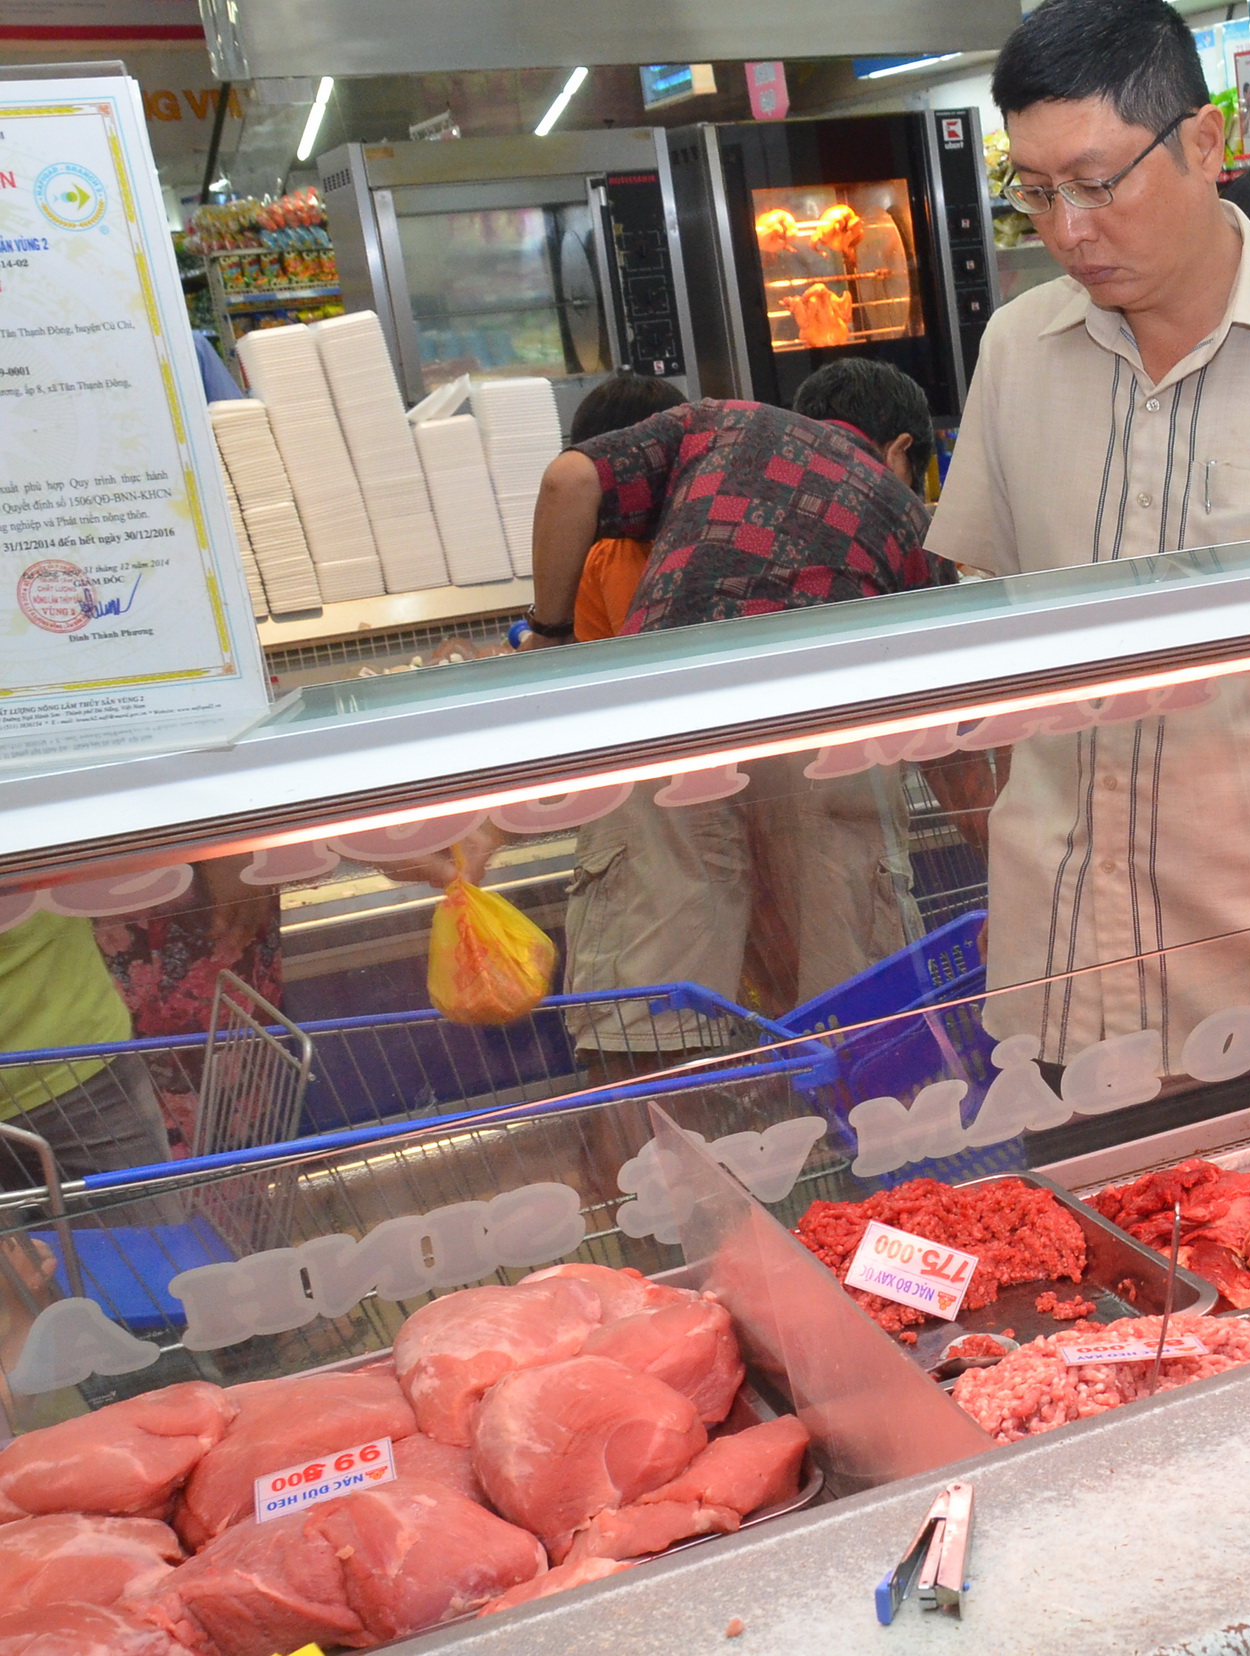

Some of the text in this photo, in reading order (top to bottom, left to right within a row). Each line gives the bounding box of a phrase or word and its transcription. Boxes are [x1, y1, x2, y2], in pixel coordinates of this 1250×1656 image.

[69, 477, 90, 490] Quy
[3, 537, 56, 552] 31/12/2014
[124, 527, 176, 542] 30/12/2016
[150, 558, 170, 568] 2014
[874, 1234, 969, 1284] 175.000
[859, 1264, 875, 1282] ÚC
[876, 1270, 897, 1287] XAY
[895, 1276, 912, 1294] BÒ
[911, 1282, 936, 1301] NẠC
[266, 1473, 364, 1512] NẠC ĐÙI HEO
